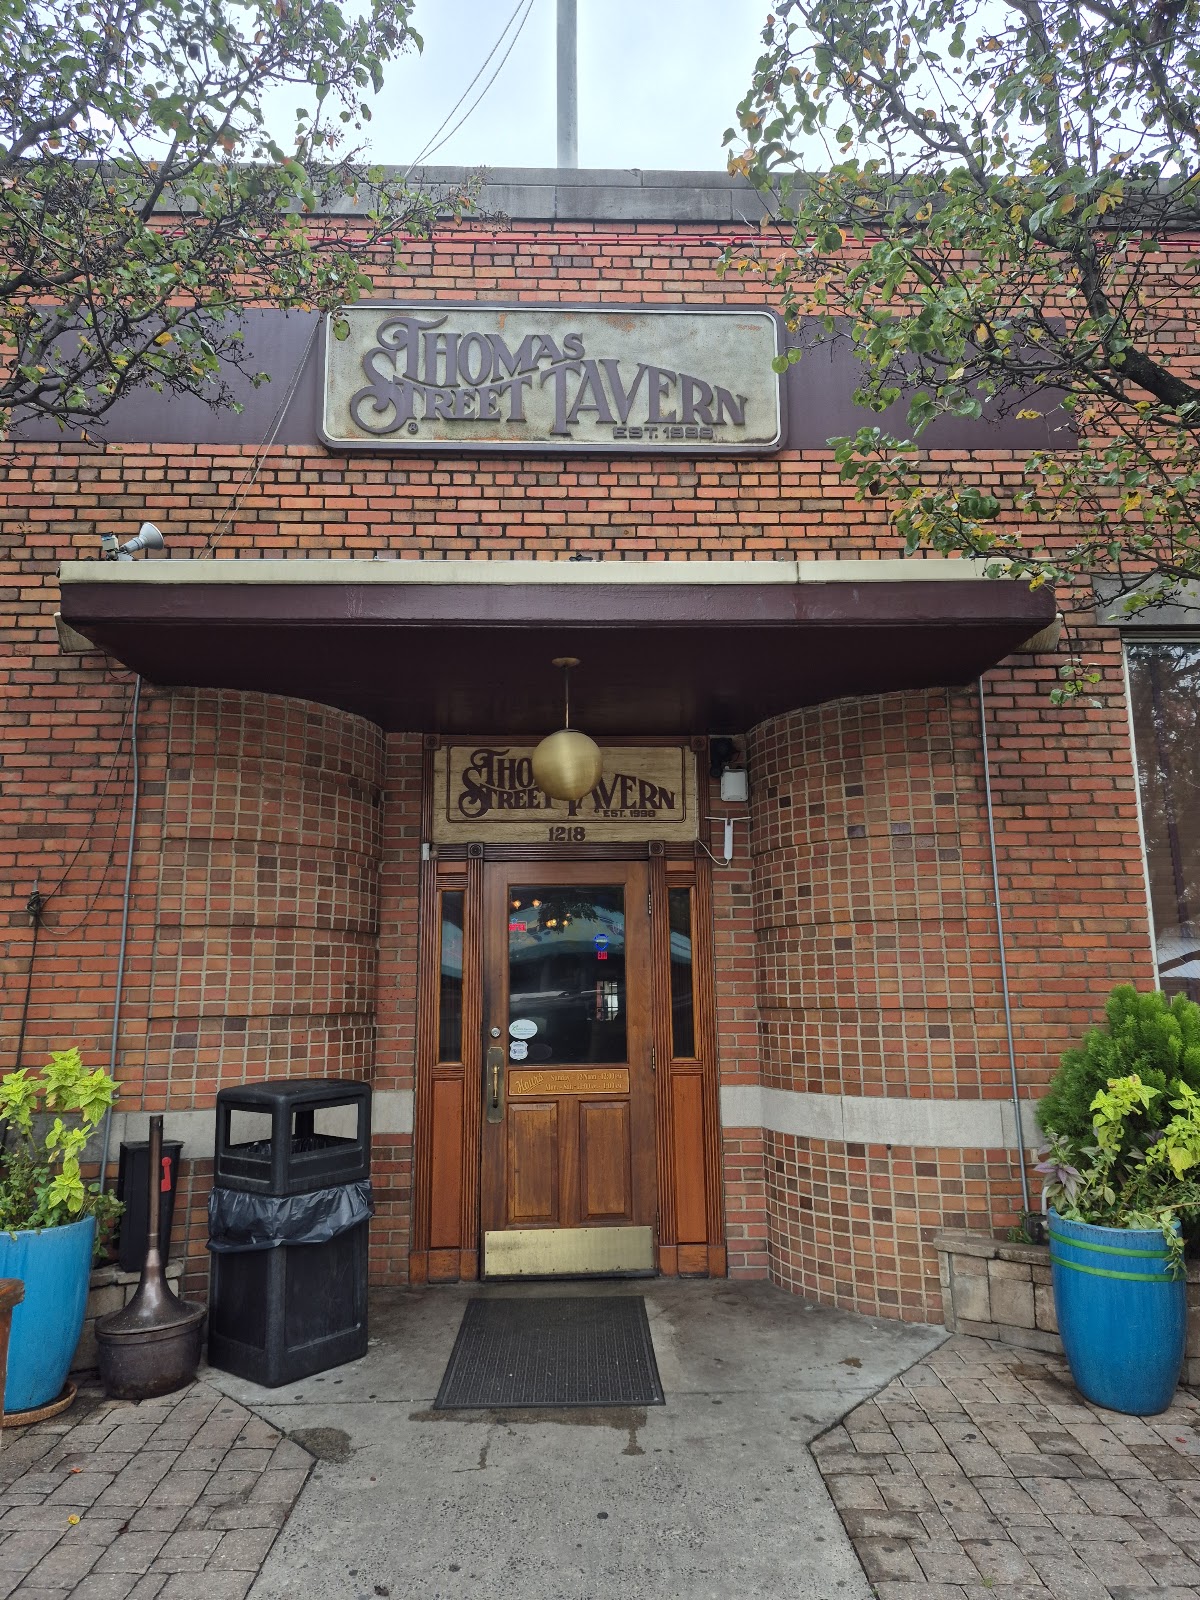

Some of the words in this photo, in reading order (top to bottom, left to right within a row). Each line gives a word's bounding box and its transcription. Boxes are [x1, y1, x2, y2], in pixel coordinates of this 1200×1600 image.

[377, 314, 586, 386] THOMAS
[349, 346, 532, 434] STREET
[540, 358, 748, 436] TAVERN
[612, 426, 658, 440] EST.
[470, 749, 534, 791] THO
[602, 809, 627, 818] EST.
[548, 826, 586, 842] 1218
